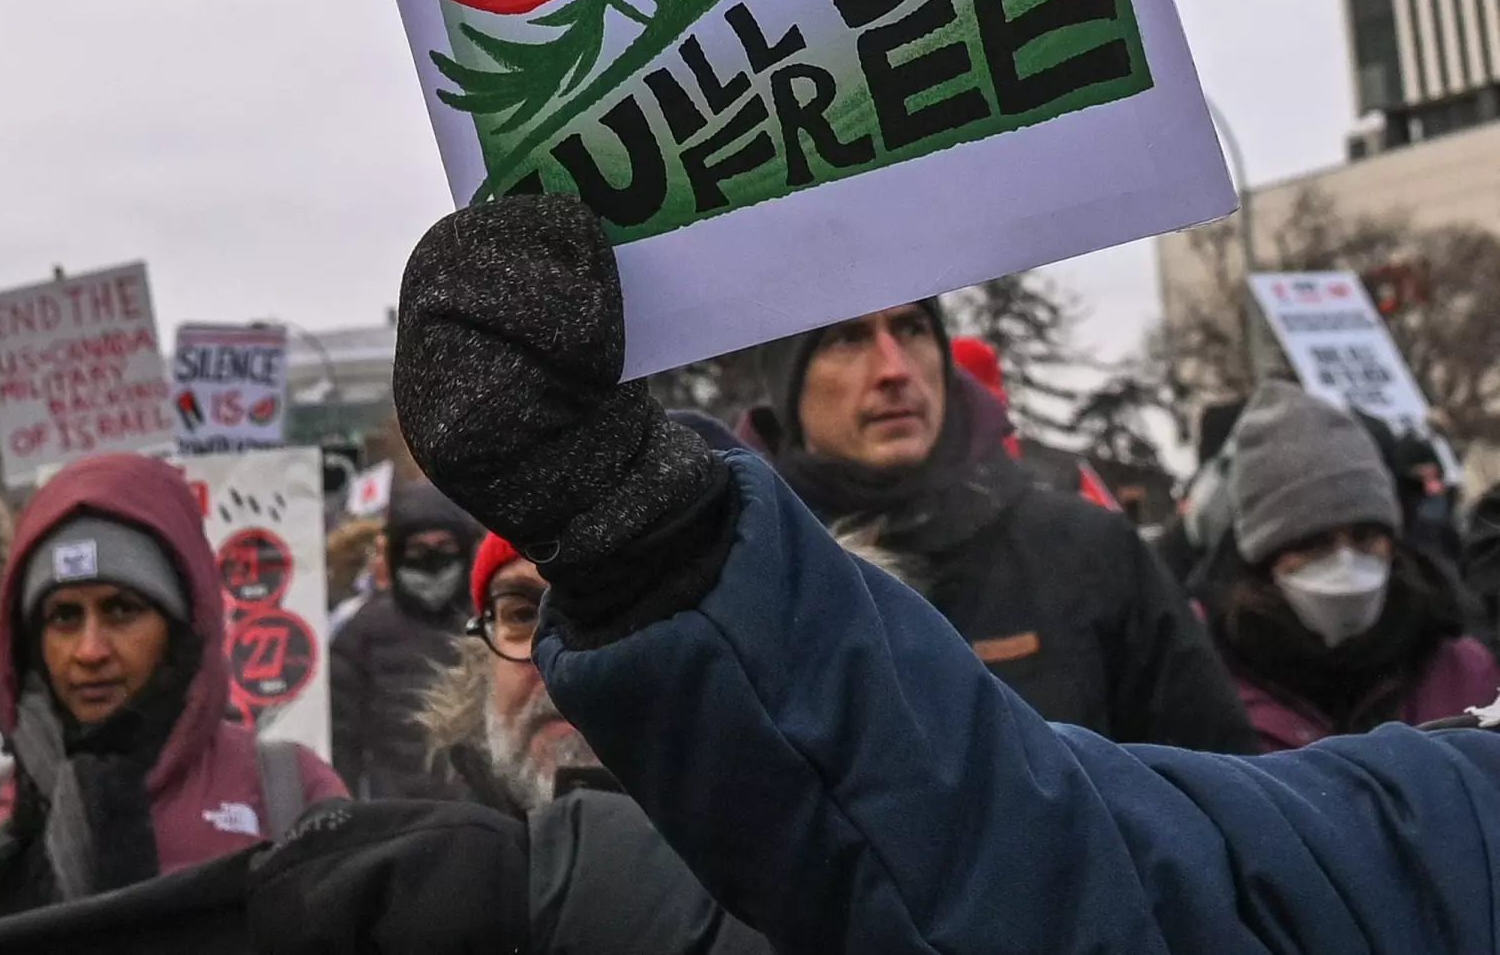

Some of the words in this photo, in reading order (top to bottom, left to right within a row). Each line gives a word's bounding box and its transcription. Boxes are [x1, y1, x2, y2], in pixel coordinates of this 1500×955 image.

[63, 275, 142, 328] THE
[176, 346, 283, 386] SILENCE
[210, 389, 244, 427] IS
[8, 421, 51, 458] OF
[56, 405, 175, 451] ISRAEL
